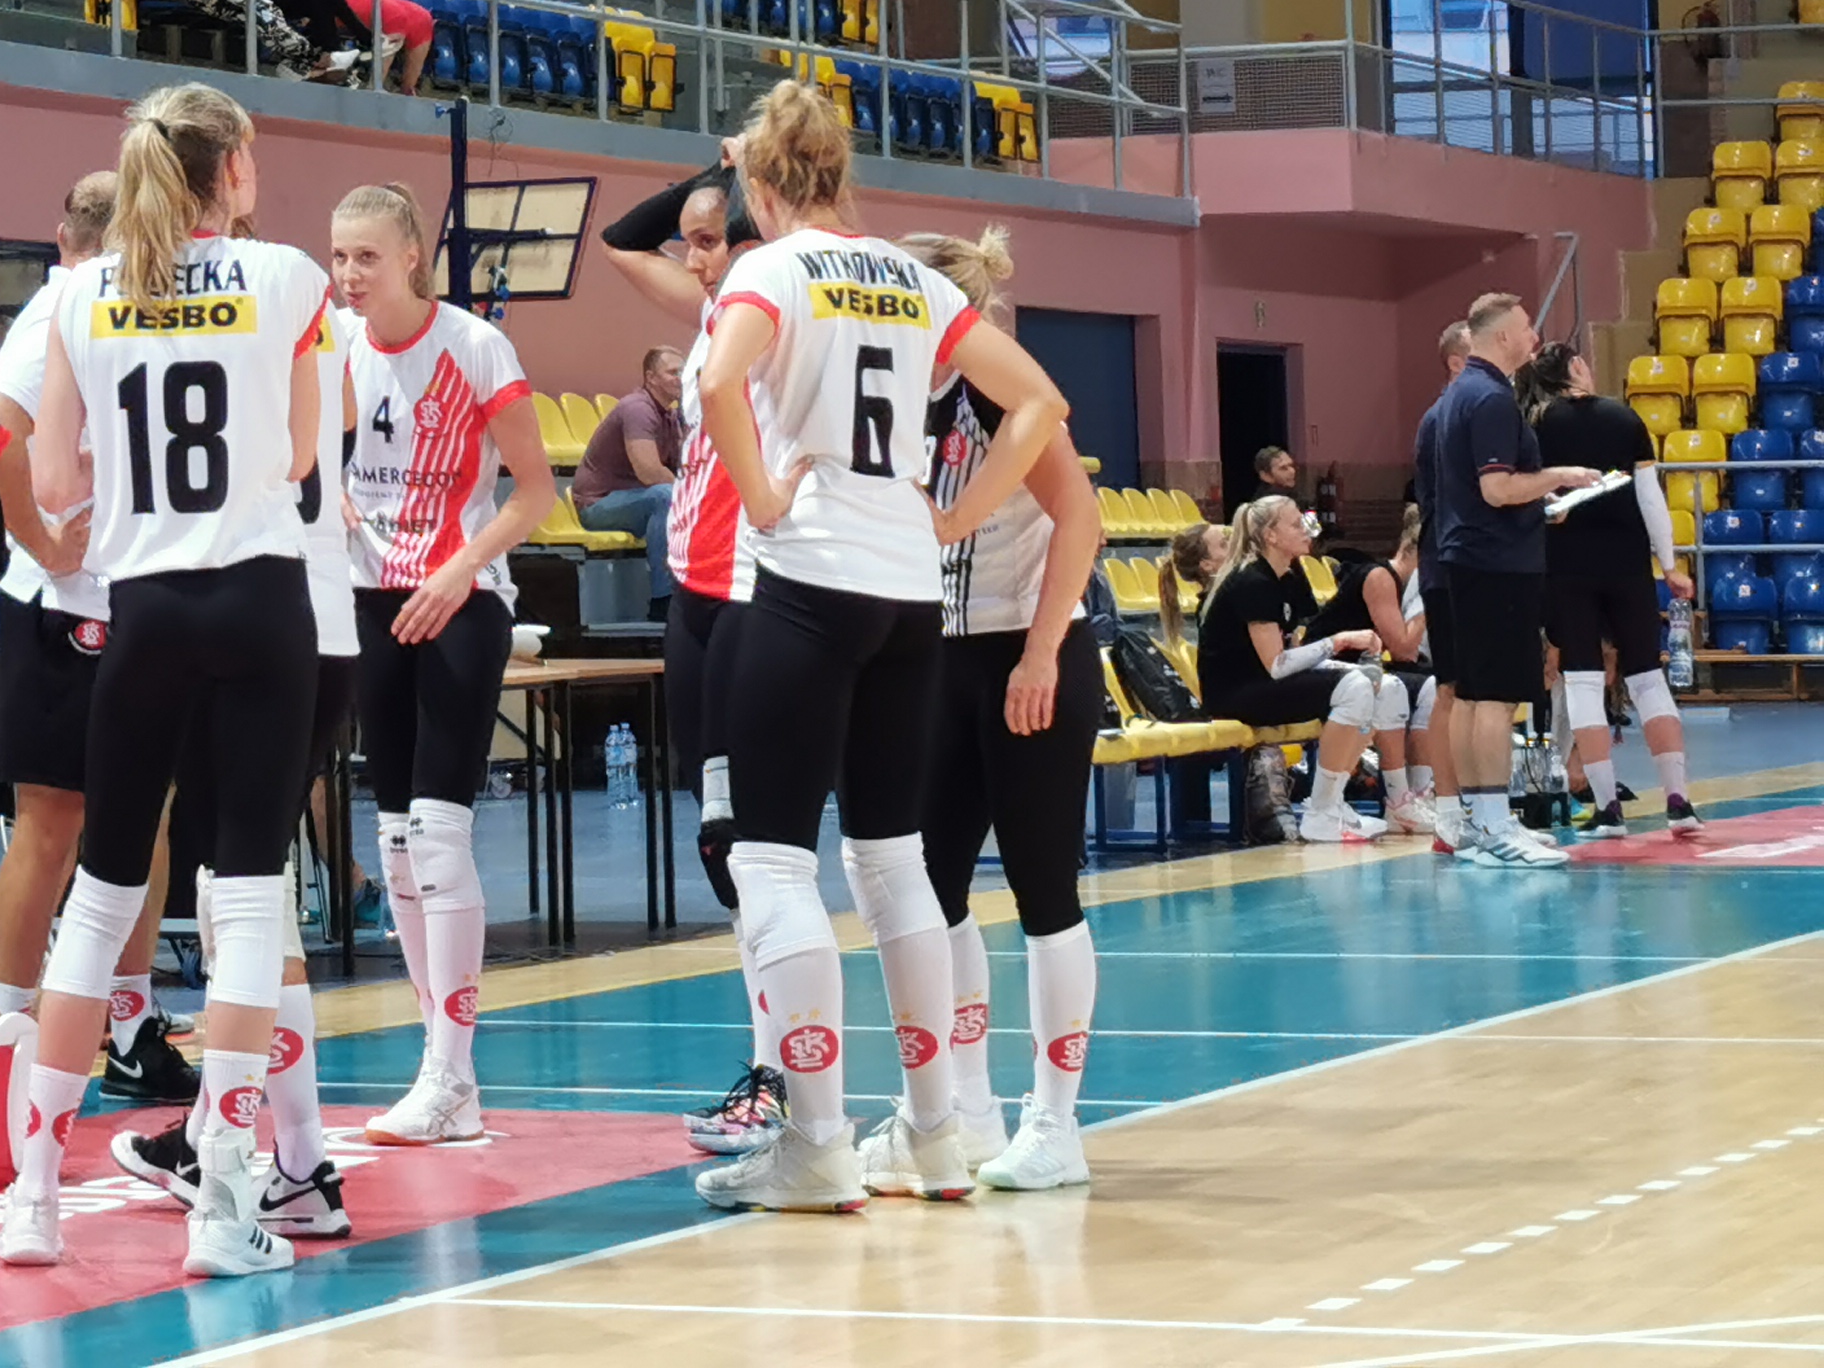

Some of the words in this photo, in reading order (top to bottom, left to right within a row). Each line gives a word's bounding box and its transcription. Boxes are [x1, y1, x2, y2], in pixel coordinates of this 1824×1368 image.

[107, 301, 239, 331] VESBO
[822, 287, 920, 320] VESBO
[371, 395, 395, 445] 4
[849, 343, 896, 479] 6
[117, 360, 229, 516] 18
